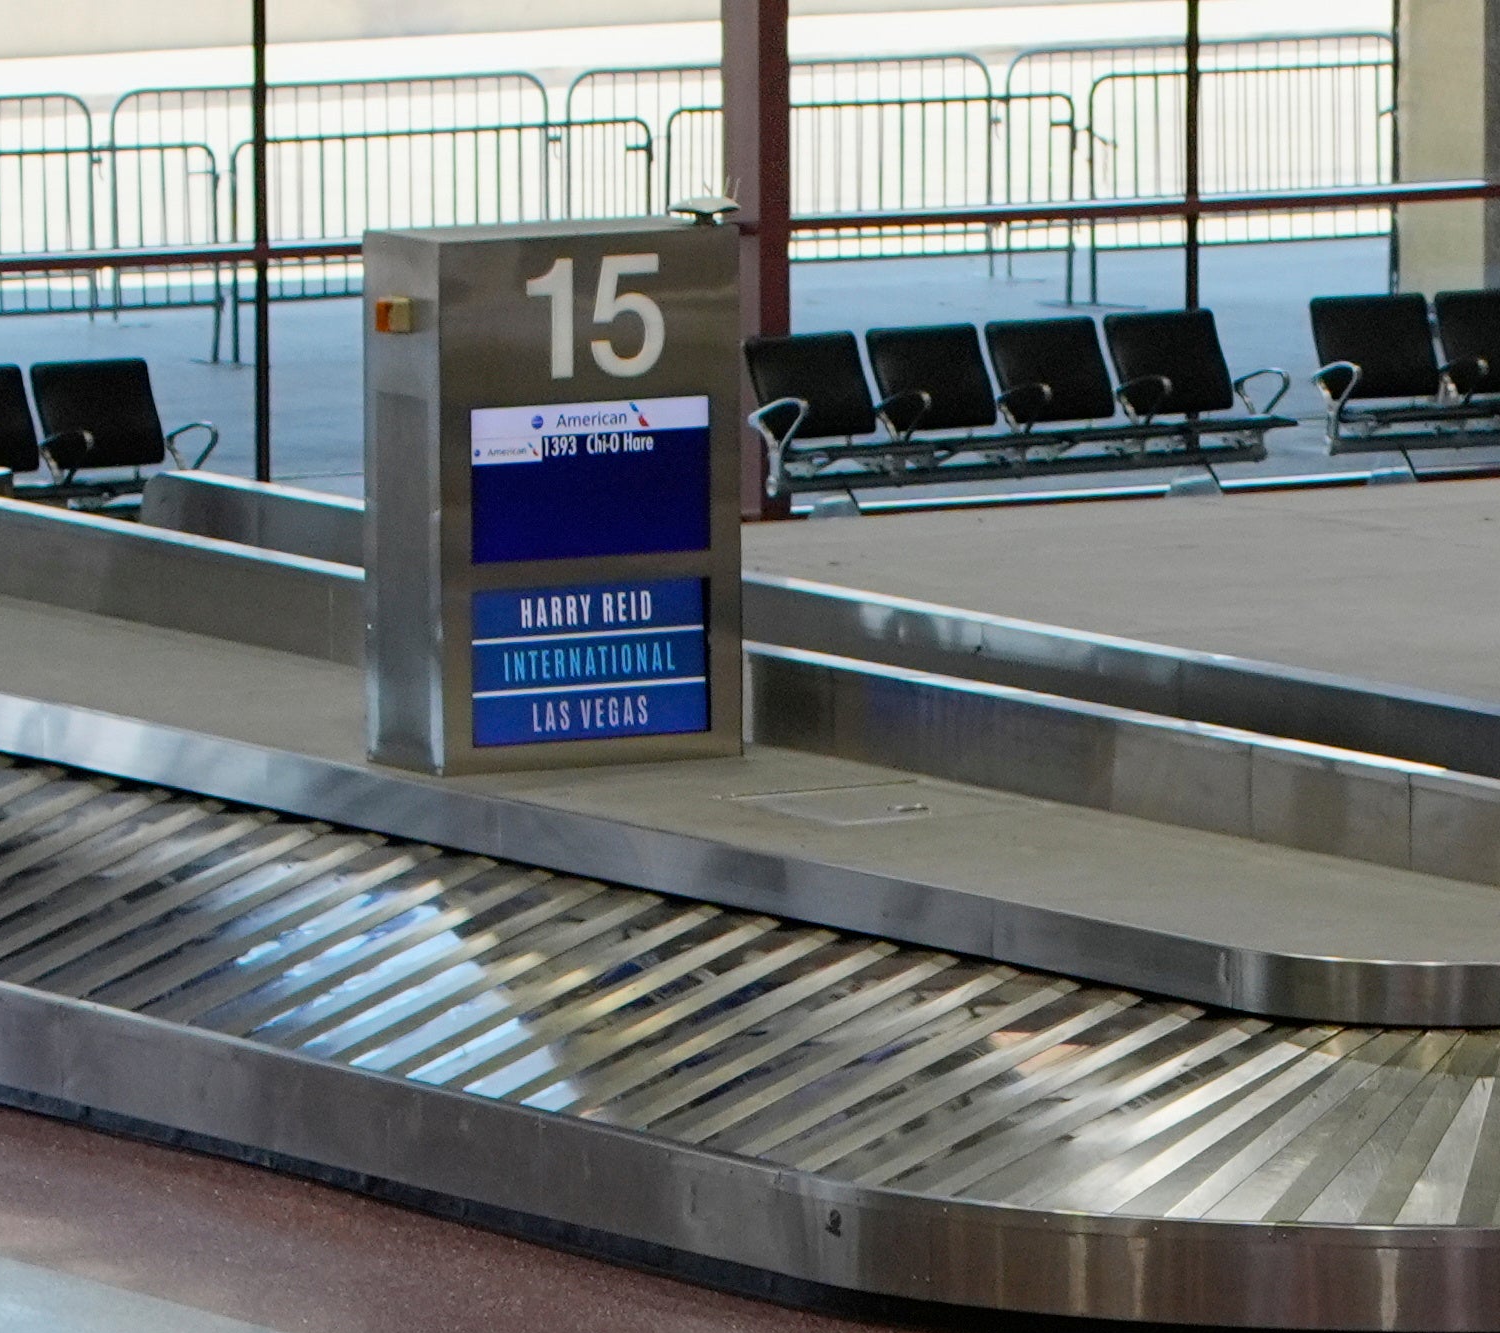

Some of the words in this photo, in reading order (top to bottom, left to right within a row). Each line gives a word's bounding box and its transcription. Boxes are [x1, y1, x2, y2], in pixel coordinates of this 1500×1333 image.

[525, 252, 666, 380] 15
[555, 410, 628, 429] American
[543, 436, 577, 457] 1393
[623, 431, 654, 452] Hare
[520, 594, 591, 629] HARRY
[601, 590, 653, 622] REID
[503, 640, 676, 682] INTERNATIONAL
[532, 699, 570, 733] LAS
[580, 694, 649, 728] VEGAS
